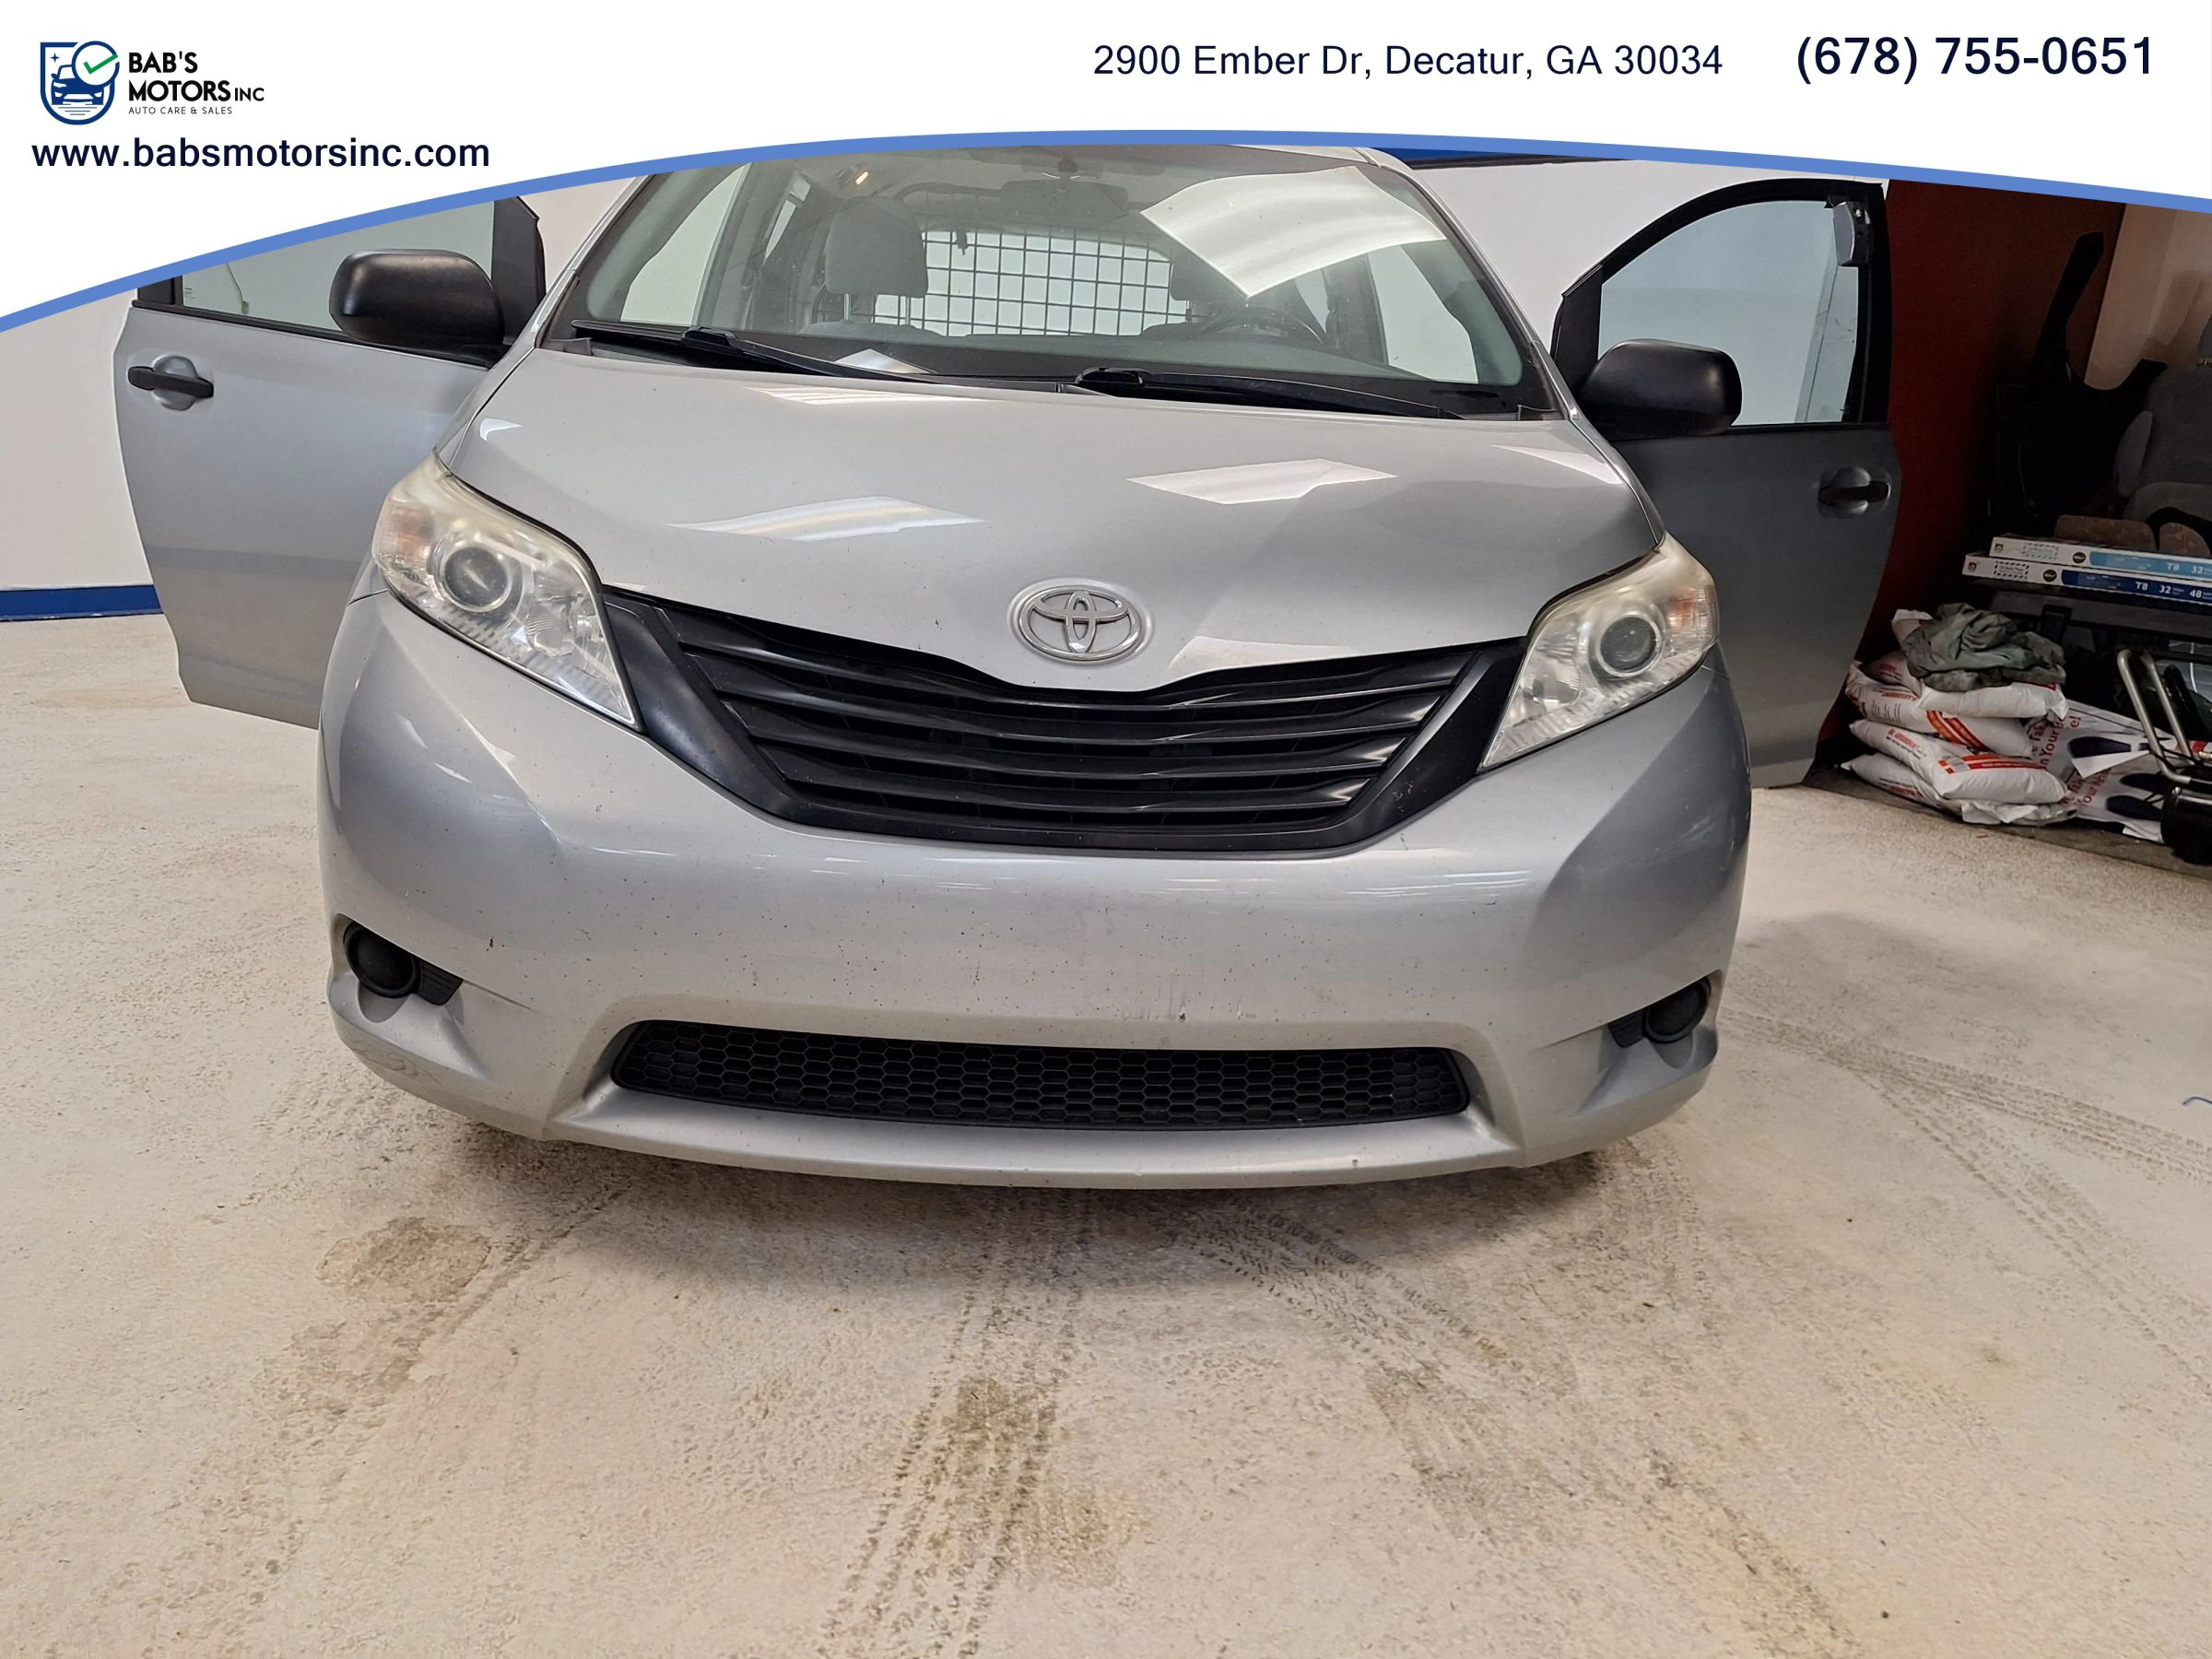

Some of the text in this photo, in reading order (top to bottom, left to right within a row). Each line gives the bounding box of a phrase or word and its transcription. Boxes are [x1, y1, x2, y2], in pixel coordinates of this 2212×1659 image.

[2135, 581, 2148, 591] T8
[2159, 584, 2171, 594] 32
[2189, 589, 2203, 599] 48
[2038, 731, 2060, 756] Your
